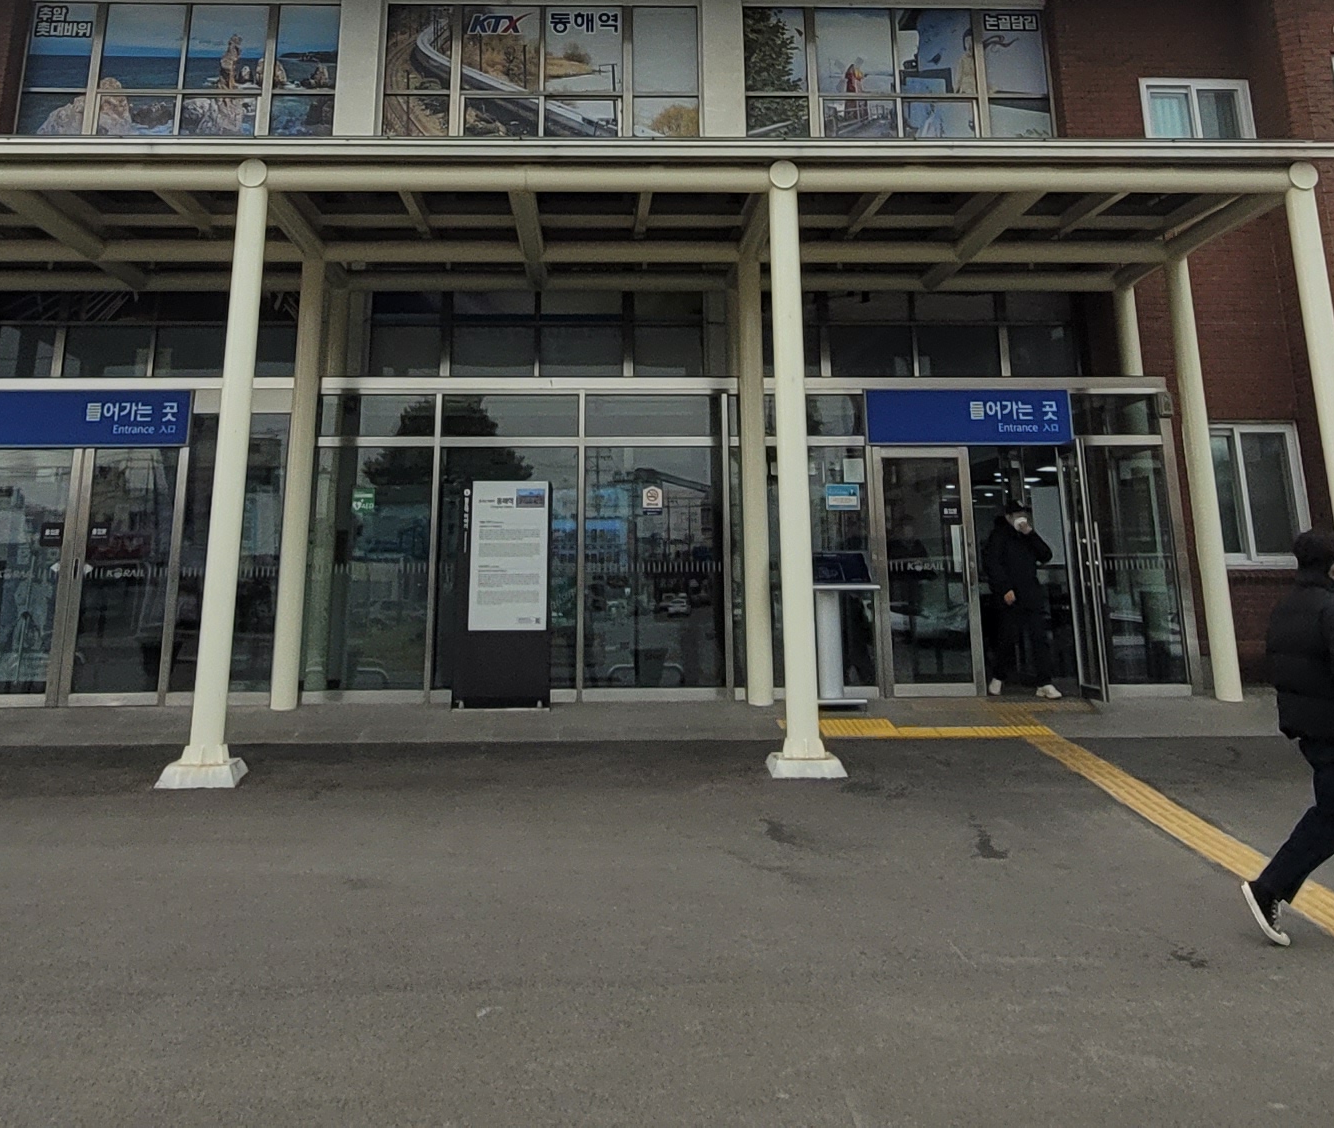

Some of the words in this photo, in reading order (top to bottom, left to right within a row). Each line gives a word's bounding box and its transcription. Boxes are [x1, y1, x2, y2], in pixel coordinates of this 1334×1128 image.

[38, 6, 67, 21] 추암
[468, 12, 535, 35] KTX
[549, 12, 620, 34] 동해역
[85, 402, 153, 421] 들어가는
[161, 402, 178, 421] 곳
[969, 401, 1034, 420] 들어가는
[1042, 401, 1058, 420] 곳
[112, 424, 155, 434] Entrance
[998, 423, 1038, 432] Entrance
